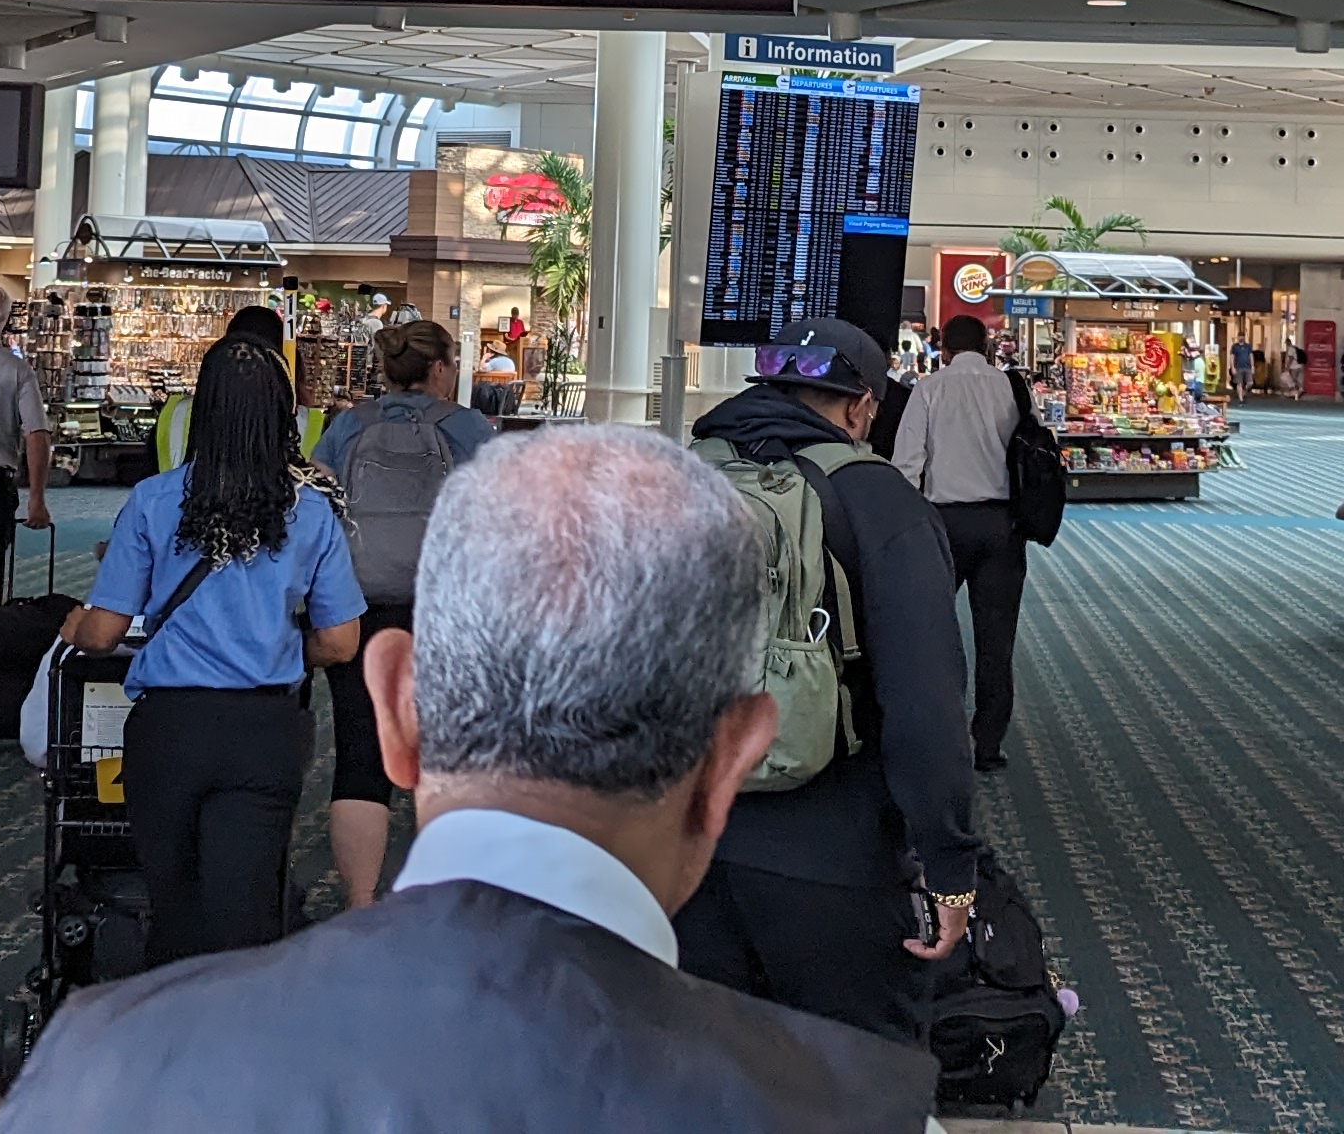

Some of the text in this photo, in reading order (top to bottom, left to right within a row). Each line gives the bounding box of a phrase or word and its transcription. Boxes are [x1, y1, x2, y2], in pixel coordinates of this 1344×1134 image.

[768, 40, 882, 67] Information
[723, 73, 757, 85] ARRIVALS
[791, 78, 833, 91] DEPARTURES
[856, 84, 898, 96] DEPARTURES
[162, 266, 189, 279] Bead
[191, 268, 232, 283] Factory
[960, 272, 987, 284] BURGER
[961, 278, 988, 293] KING
